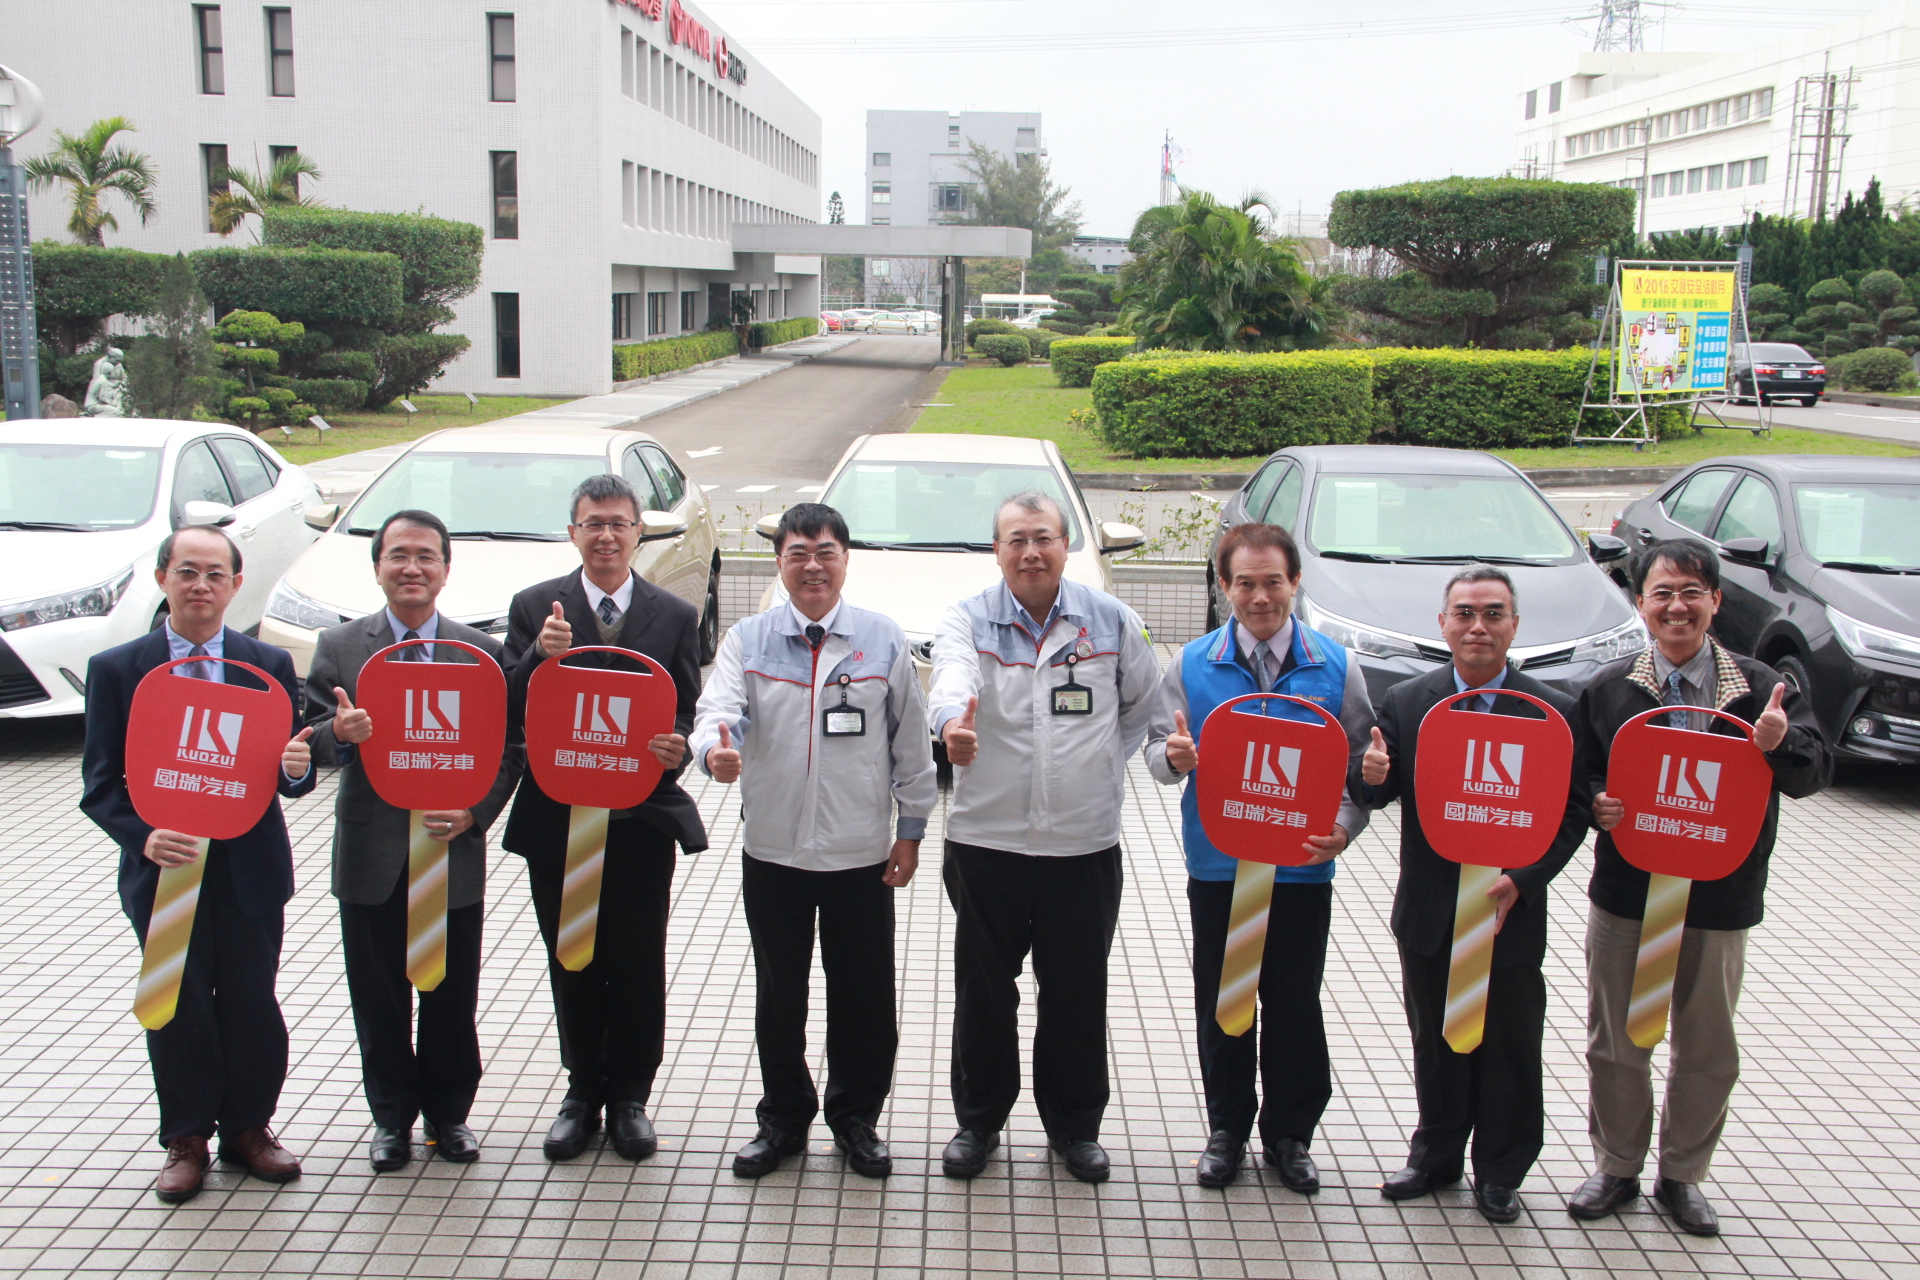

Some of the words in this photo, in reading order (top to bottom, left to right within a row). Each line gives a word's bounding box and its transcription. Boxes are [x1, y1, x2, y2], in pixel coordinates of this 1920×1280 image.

[682, 9, 711, 63] TOYOTA
[728, 50, 748, 87] HINO
[1645, 279, 1668, 294] 2016
[1671, 278, 1725, 295] 交通安全活動月
[405, 730, 460, 740] KUOZUI
[573, 730, 627, 744] KUOZUI
[177, 747, 236, 766] KUOZUI
[389, 751, 475, 770] 國瑞汽車
[555, 749, 640, 772] 國瑞汽車
[154, 768, 247, 798] 國瑞汽車
[1242, 781, 1296, 798] KUOZUI
[1463, 781, 1520, 796] KUOZUI
[1655, 794, 1715, 812] KUOZUI
[1222, 799, 1308, 828] 國瑞汽車
[1444, 801, 1533, 828] 國瑞汽車
[1635, 812, 1728, 842] 國瑞汽車
